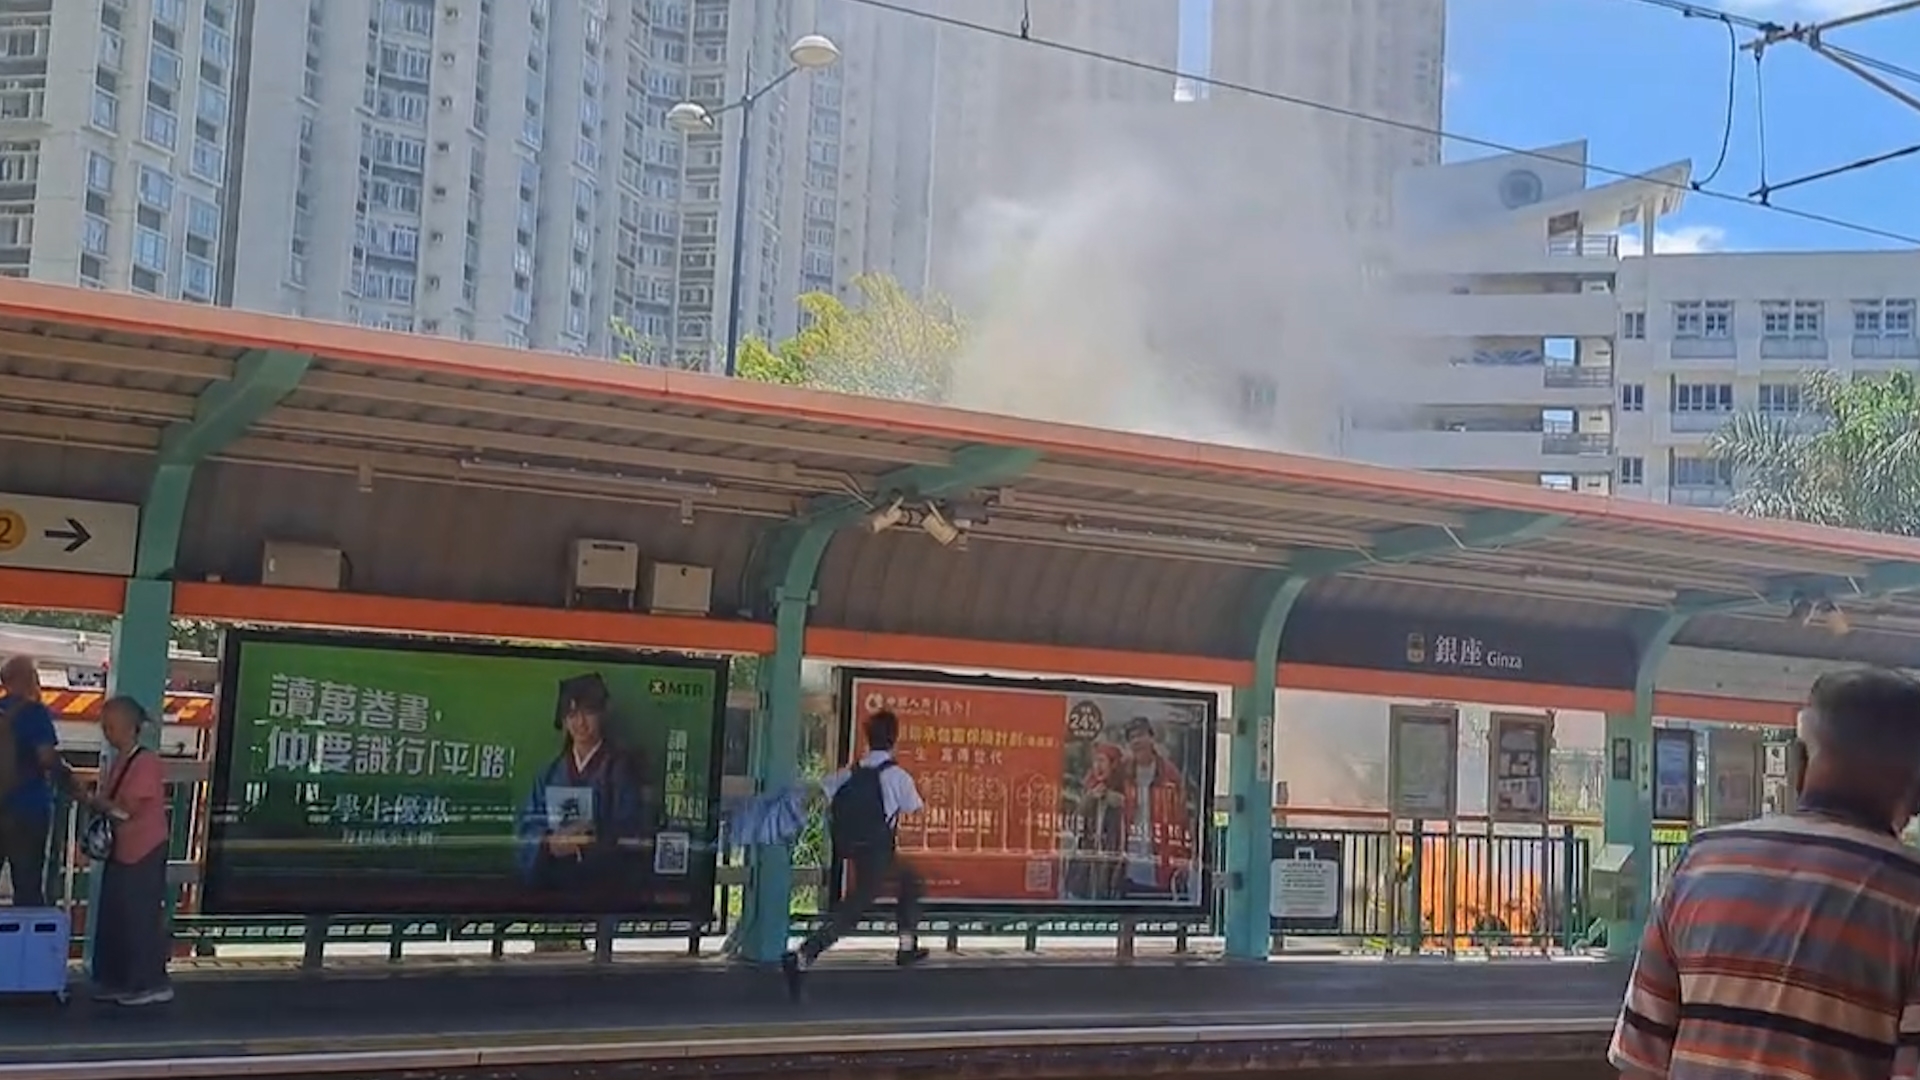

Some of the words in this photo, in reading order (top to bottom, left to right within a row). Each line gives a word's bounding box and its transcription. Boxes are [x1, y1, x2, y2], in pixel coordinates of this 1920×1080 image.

[0, 517, 12, 543] 2
[1435, 635, 1483, 666] 銀座
[1487, 651, 1523, 669] Ginza
[668, 682, 703, 697] MTR
[1069, 713, 1101, 731] 24%
